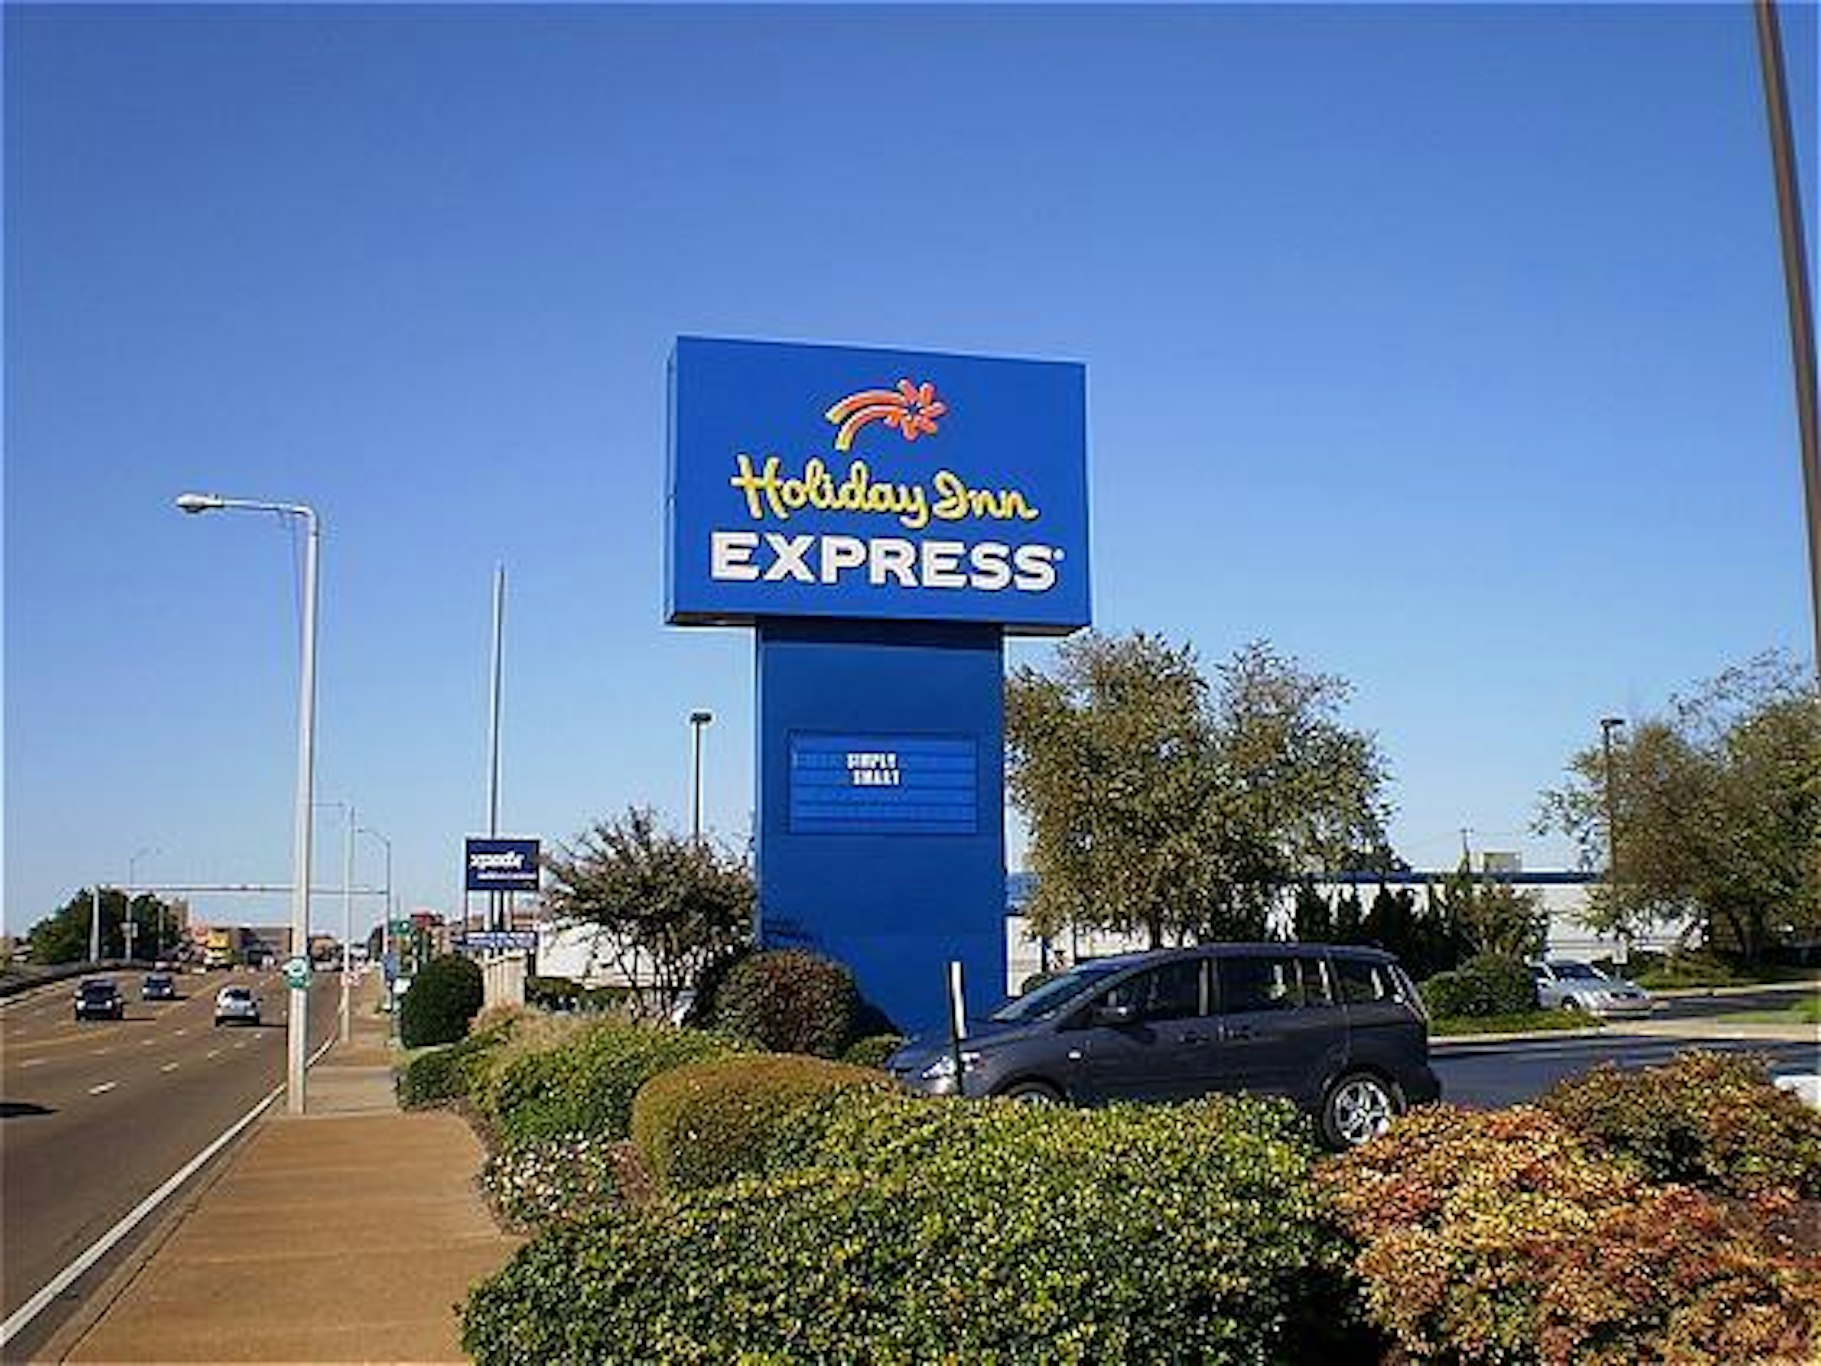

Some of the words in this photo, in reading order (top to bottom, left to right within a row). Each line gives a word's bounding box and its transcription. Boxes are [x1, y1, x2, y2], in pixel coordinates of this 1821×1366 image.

[731, 454, 929, 528] Holiday
[932, 471, 1039, 520] Inn
[710, 531, 1058, 591] EXPRESS
